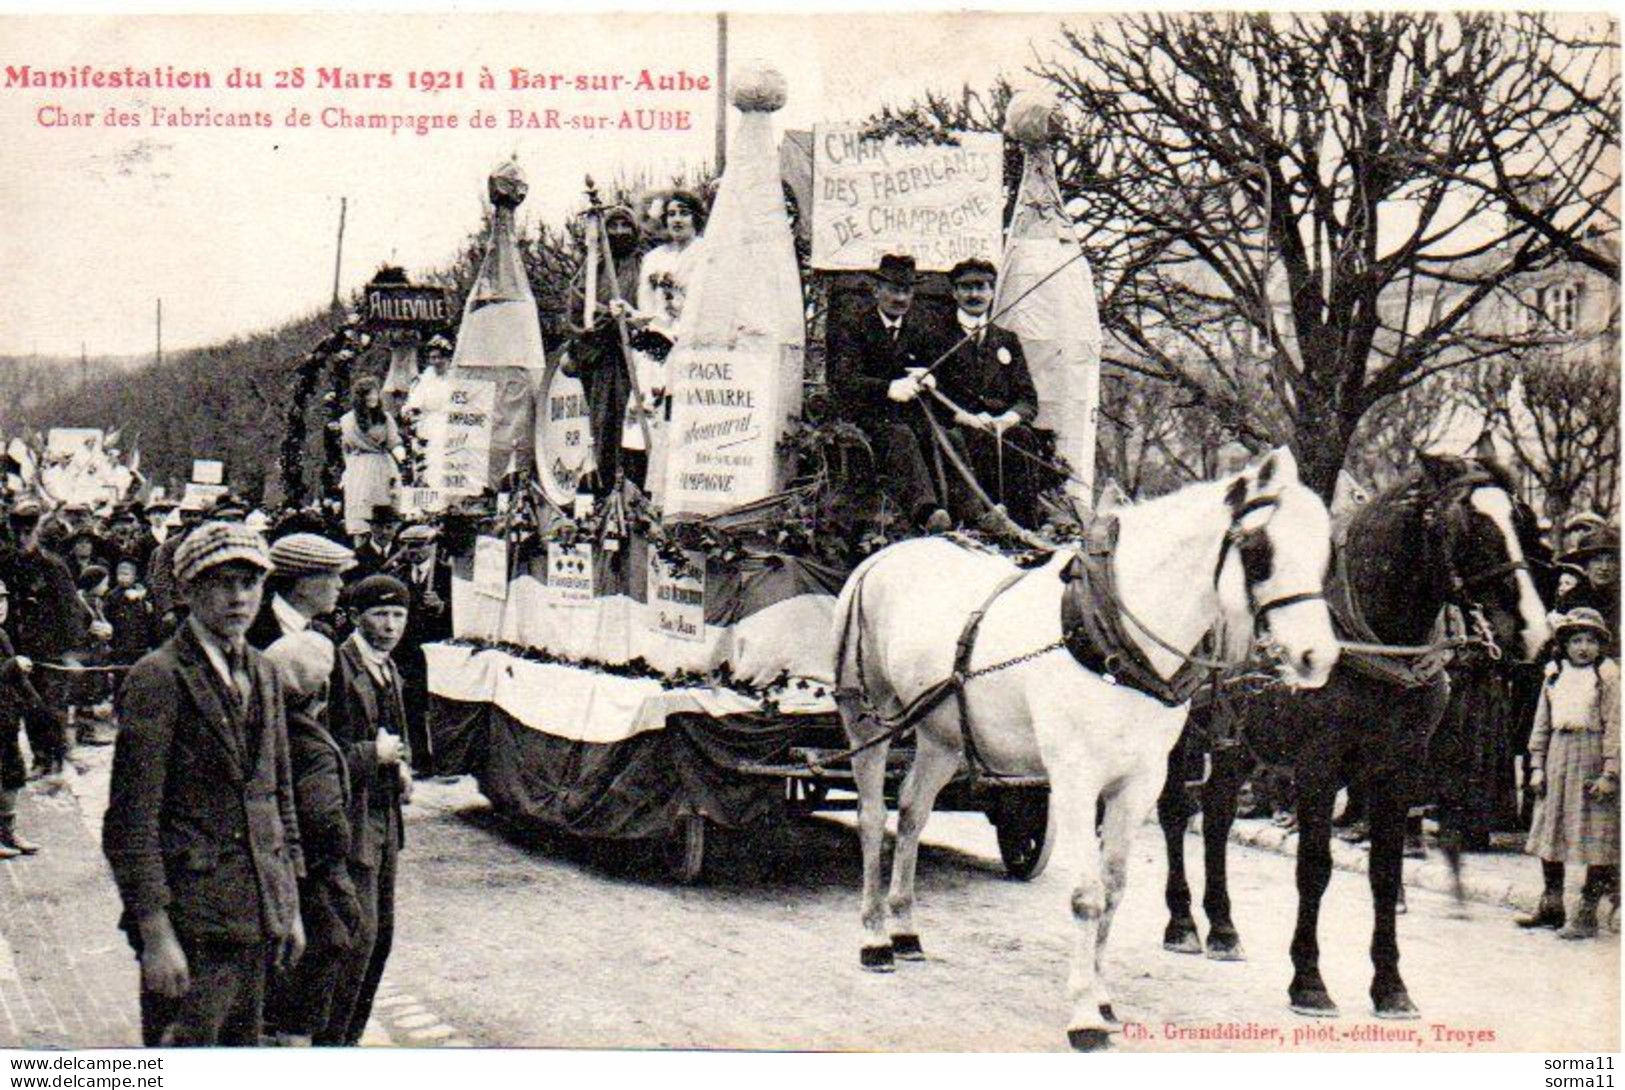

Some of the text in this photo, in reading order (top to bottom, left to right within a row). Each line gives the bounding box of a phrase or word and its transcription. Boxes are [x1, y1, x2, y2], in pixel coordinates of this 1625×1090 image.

[825, 133, 890, 167] CHAR
[824, 150, 991, 208] DES FABRICANTS
[832, 194, 992, 247] DE CHAMPAGNE
